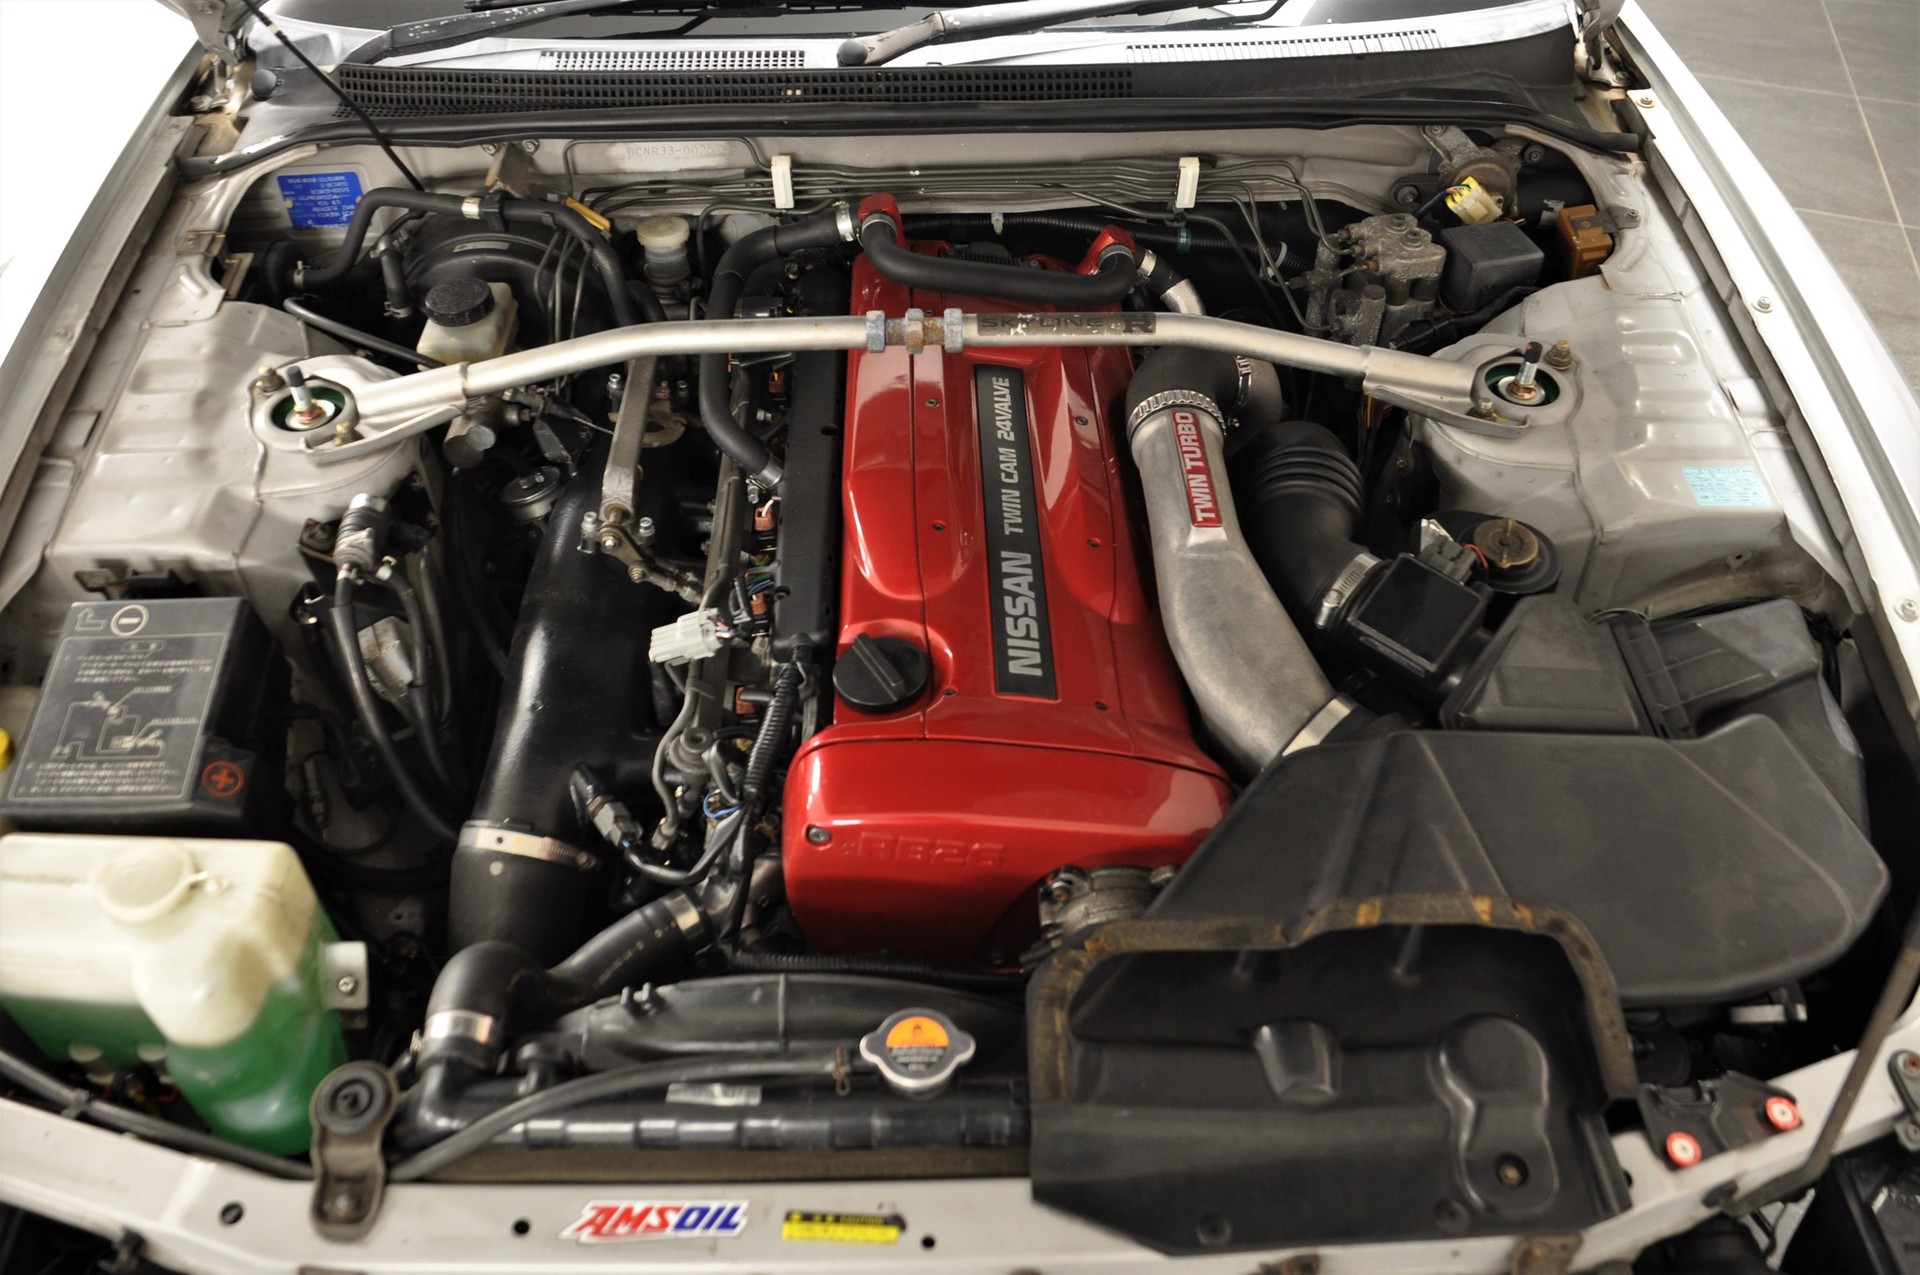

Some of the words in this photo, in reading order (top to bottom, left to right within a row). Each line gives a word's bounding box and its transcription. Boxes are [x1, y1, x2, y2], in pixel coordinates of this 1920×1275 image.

[980, 317, 1103, 328] SKYLINE
[992, 376, 1015, 442] 24VALVE
[1175, 412, 1205, 470] TURBO
[998, 447, 1019, 484] CAM
[1001, 489, 1024, 536] TWIN
[1187, 473, 1216, 522] TWIN
[1000, 550, 1043, 677] NISSAN
[573, 1205, 742, 1236] AMSOIL
